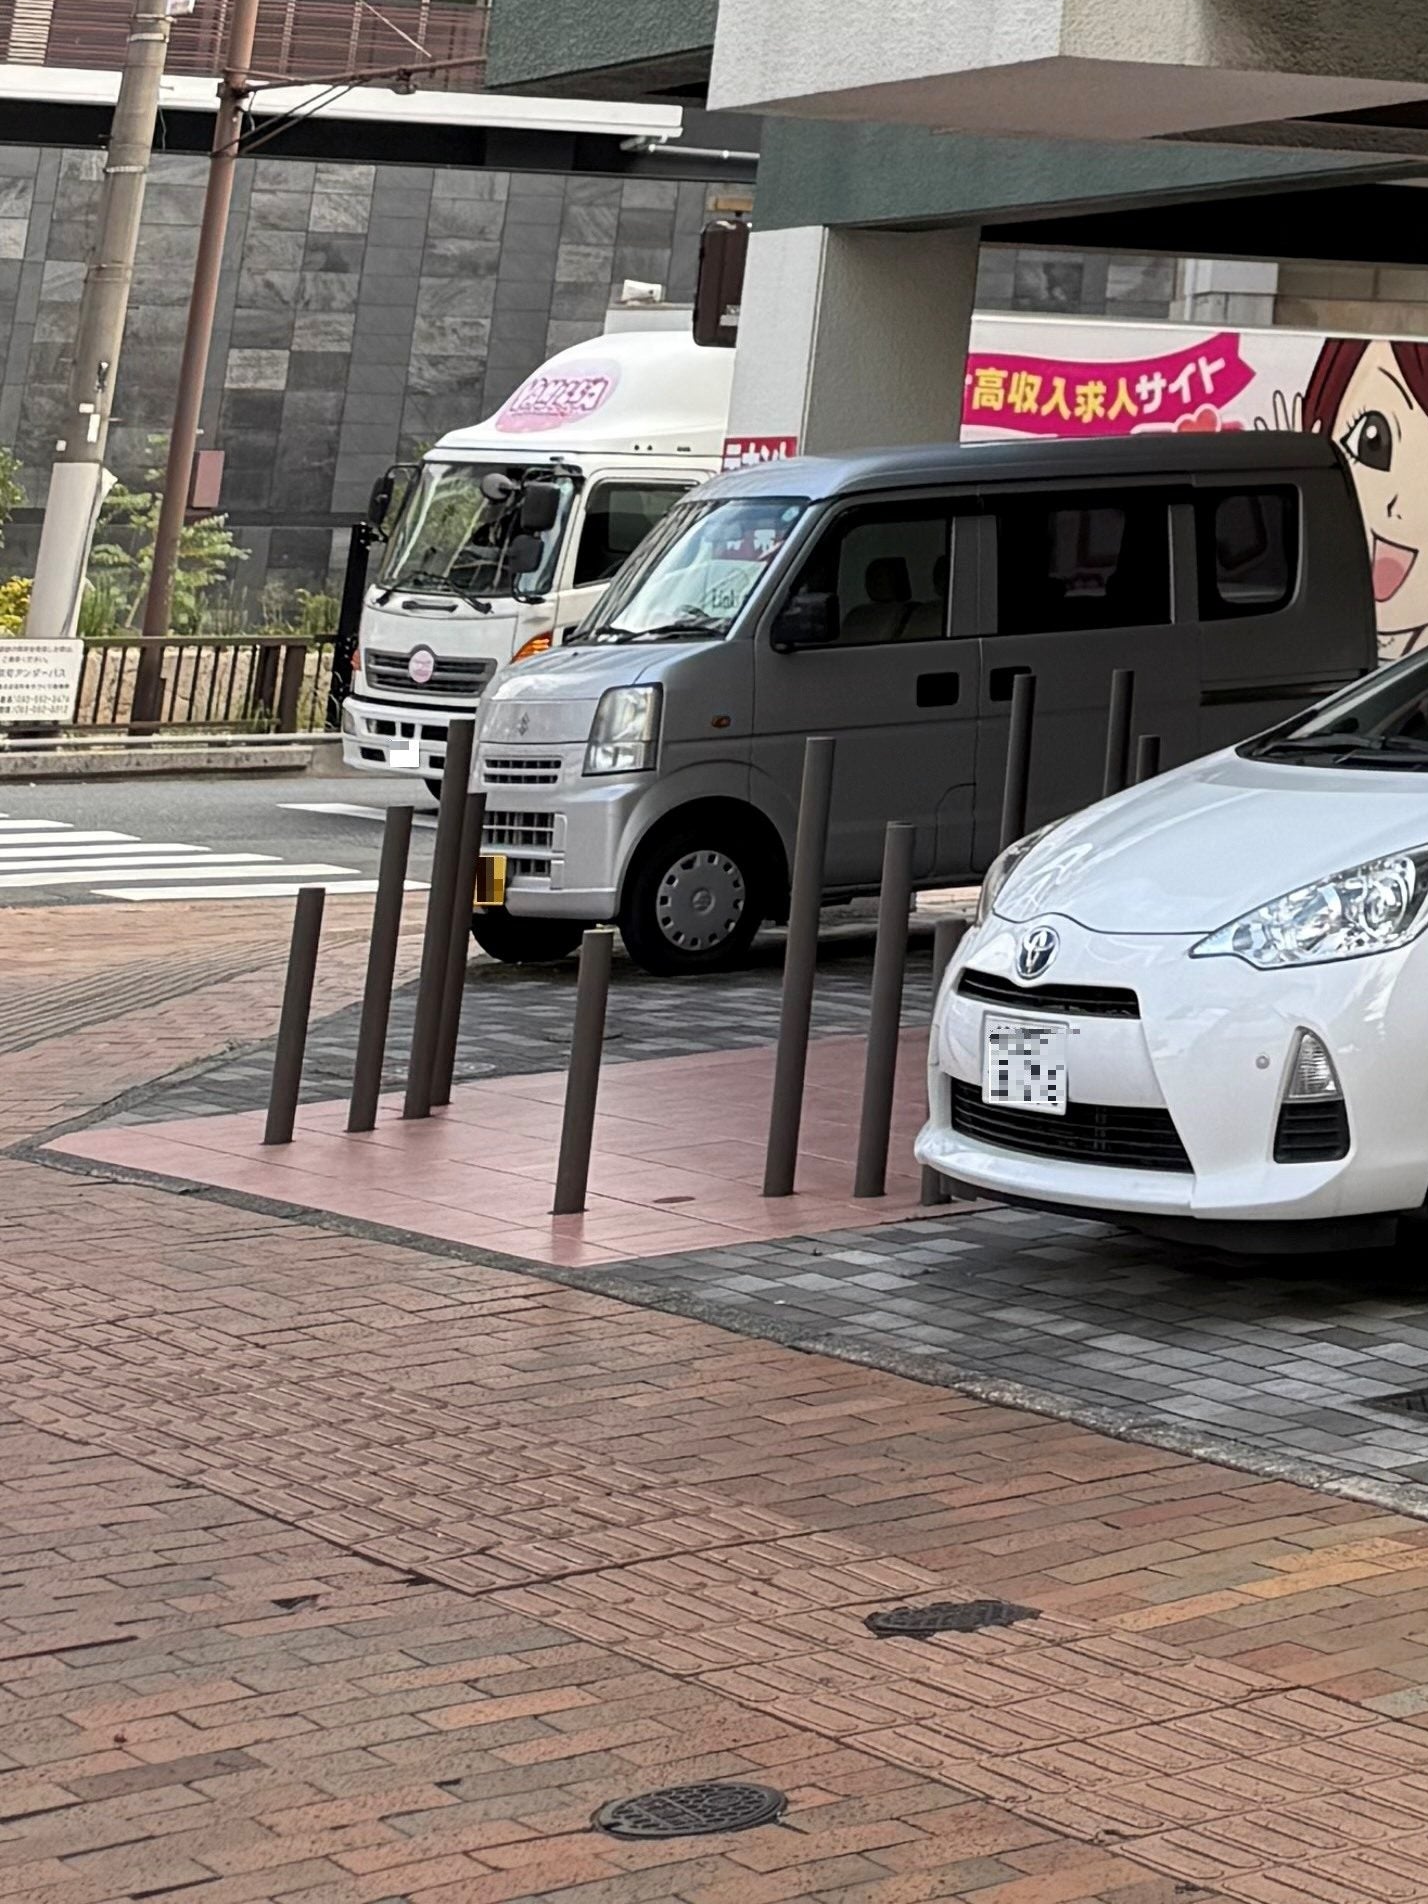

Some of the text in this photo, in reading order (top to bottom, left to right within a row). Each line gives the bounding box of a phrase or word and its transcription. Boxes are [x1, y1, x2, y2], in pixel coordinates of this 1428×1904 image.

[971, 356, 1226, 423] 高収入求人サイト
